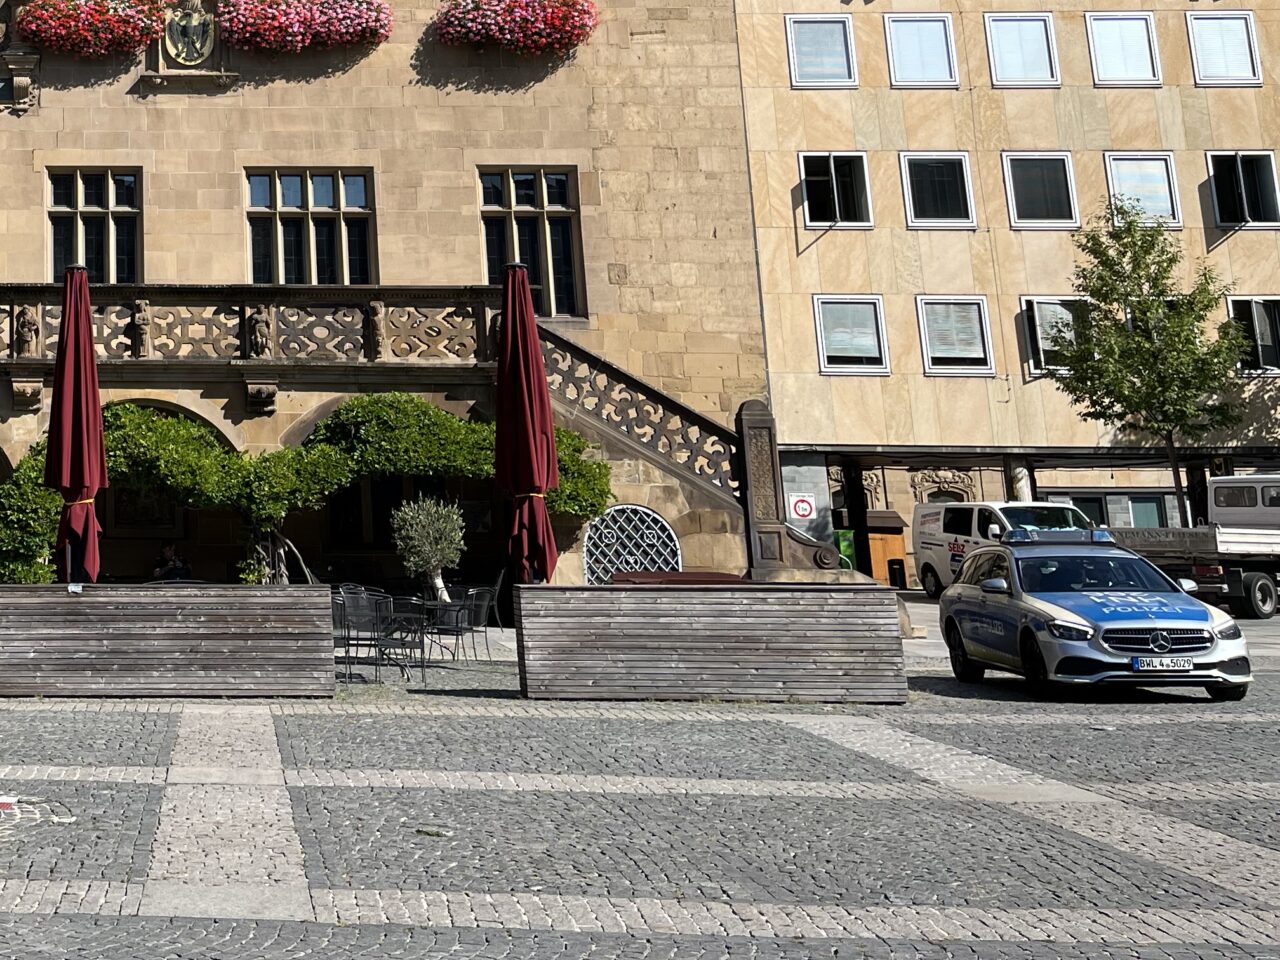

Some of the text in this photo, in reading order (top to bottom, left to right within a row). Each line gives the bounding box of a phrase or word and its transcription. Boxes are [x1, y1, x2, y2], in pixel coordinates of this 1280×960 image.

[1102, 606, 1182, 614] POLIZEI
[1140, 659, 1191, 668] BWL 4 5029
